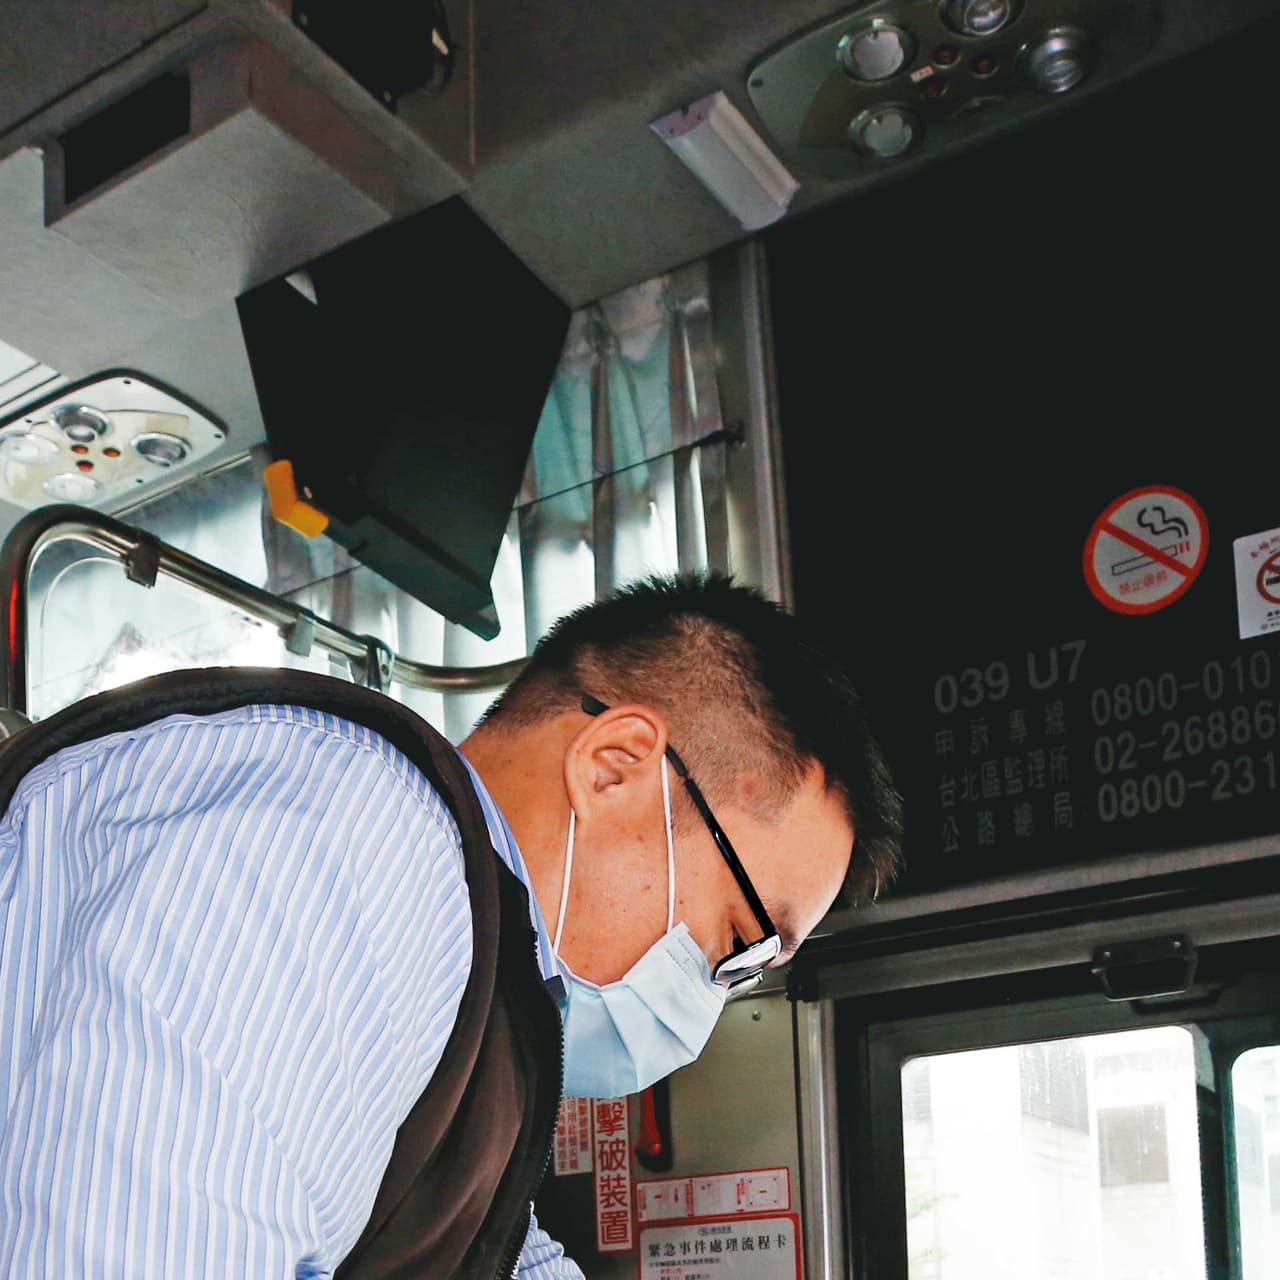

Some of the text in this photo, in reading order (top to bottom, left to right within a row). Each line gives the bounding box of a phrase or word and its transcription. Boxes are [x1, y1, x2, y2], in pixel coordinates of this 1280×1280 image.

[934, 639, 1088, 715] 039 U7
[648, 1233, 787, 1258] 緊急事件處理流程卡
